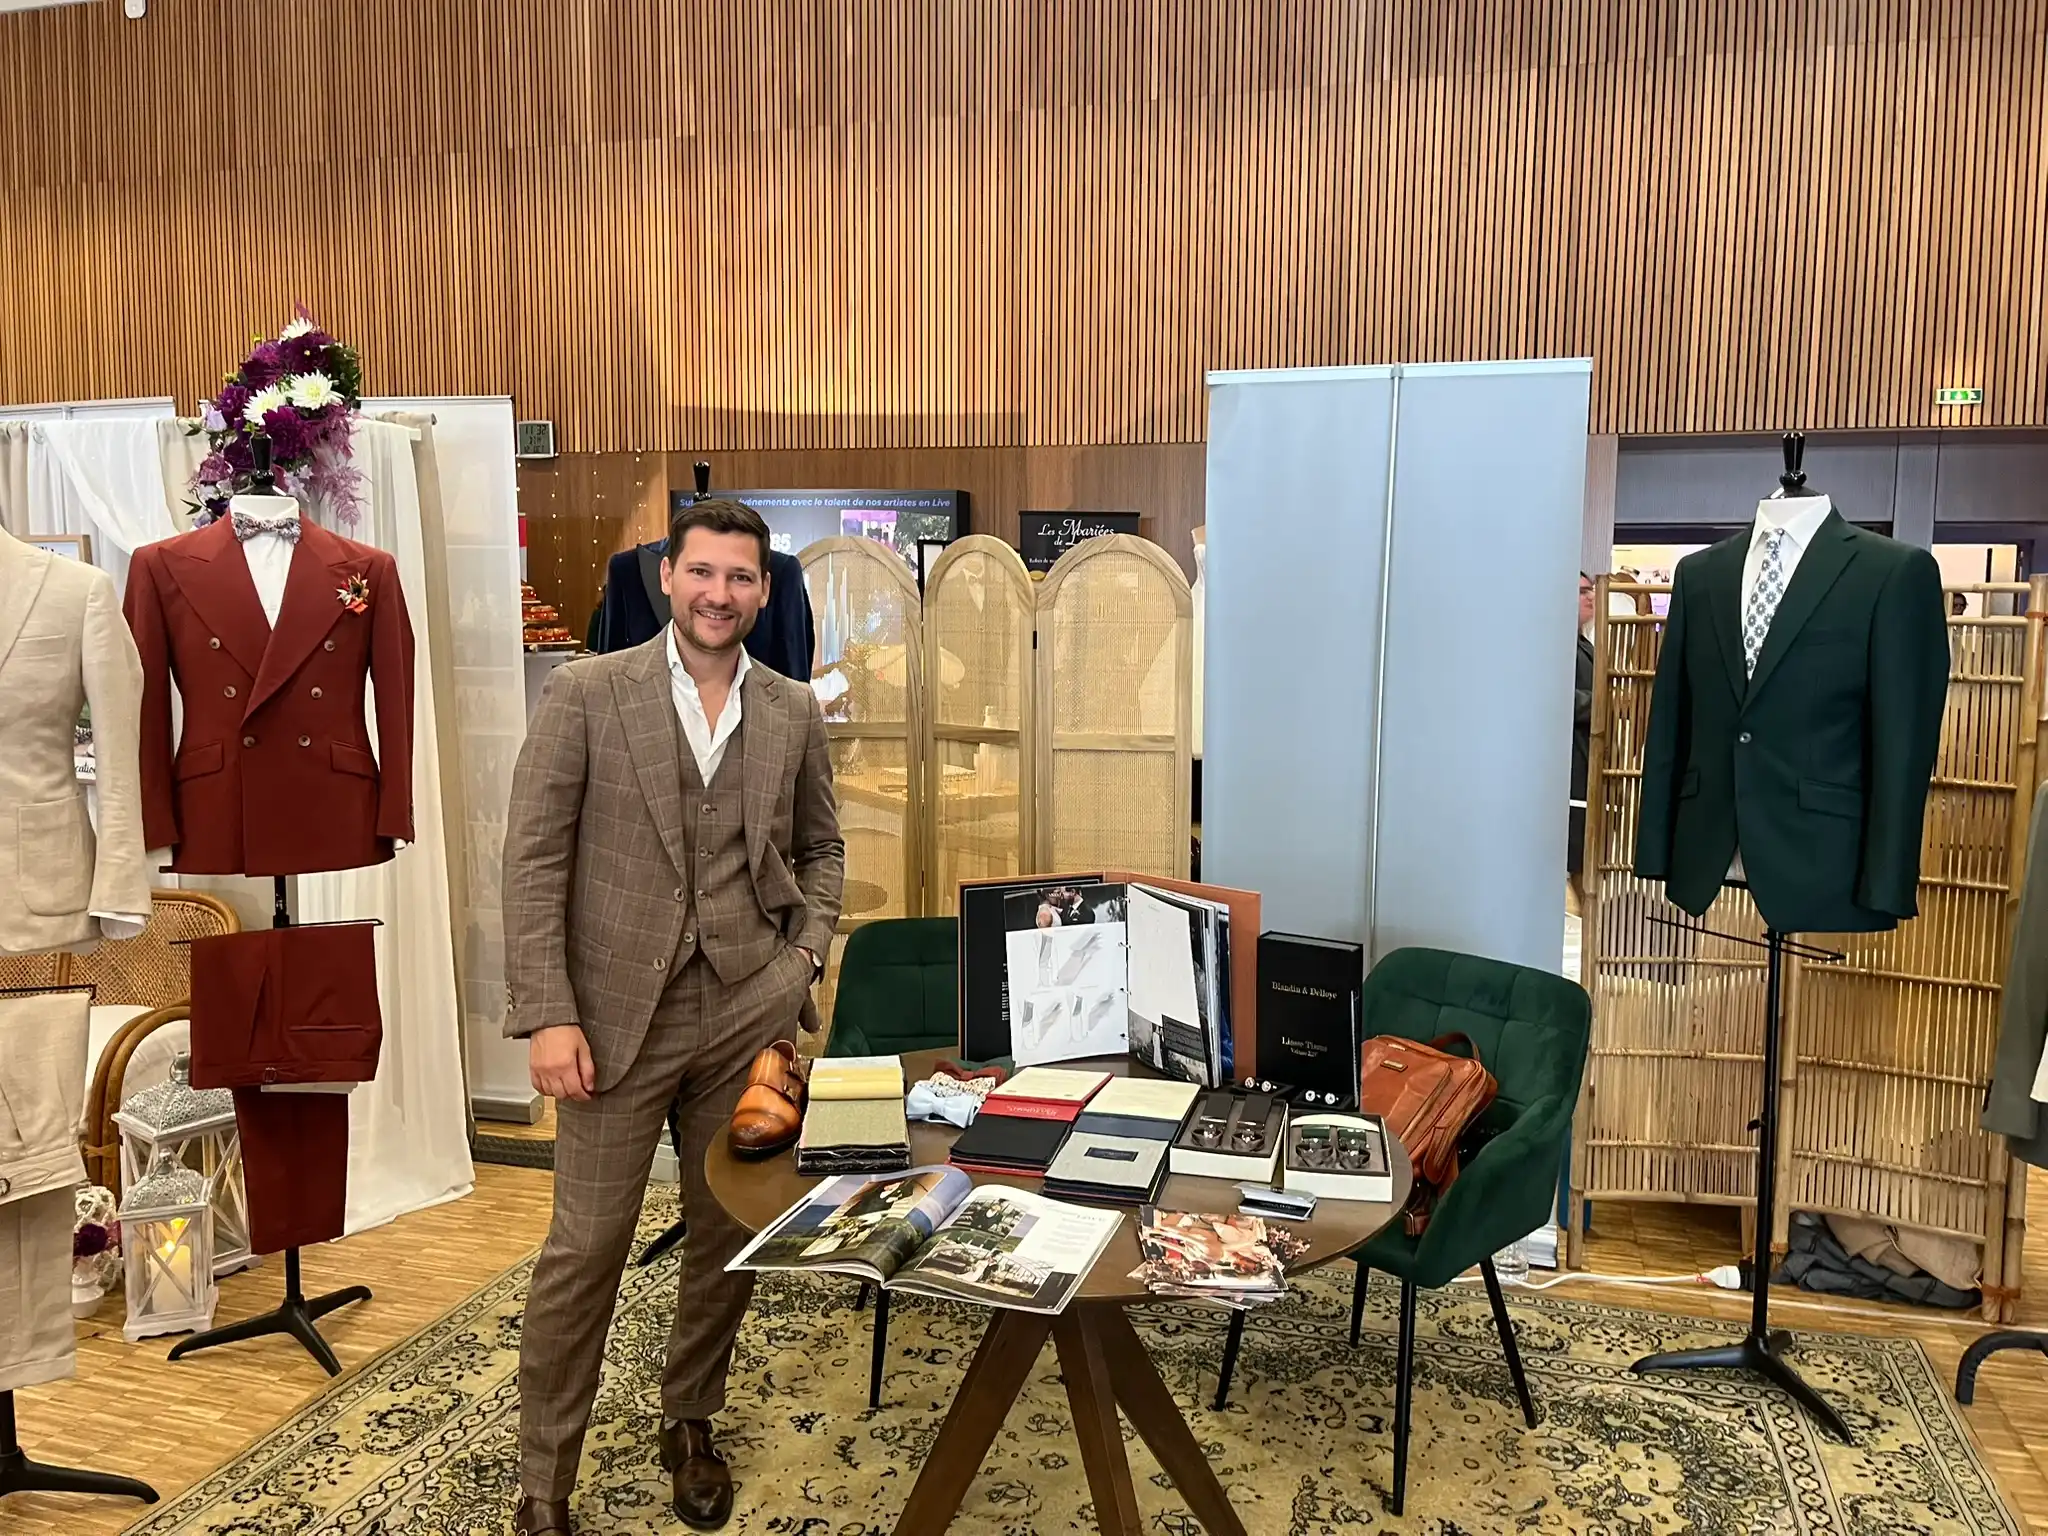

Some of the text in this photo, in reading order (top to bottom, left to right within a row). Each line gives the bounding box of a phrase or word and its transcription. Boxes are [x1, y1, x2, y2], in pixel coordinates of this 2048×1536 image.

[791, 499, 812, 507] avec
[814, 497, 824, 507] le
[824, 497, 851, 507] talent
[852, 497, 865, 507] de
[865, 499, 882, 507] nos
[883, 497, 917, 508] artistes
[918, 500, 930, 508] en
[932, 498, 951, 508] Live
[1037, 518, 1115, 537] Les Mariées
[1053, 535, 1063, 546] de
[1271, 980, 1338, 1000] Blandin & Delloye
